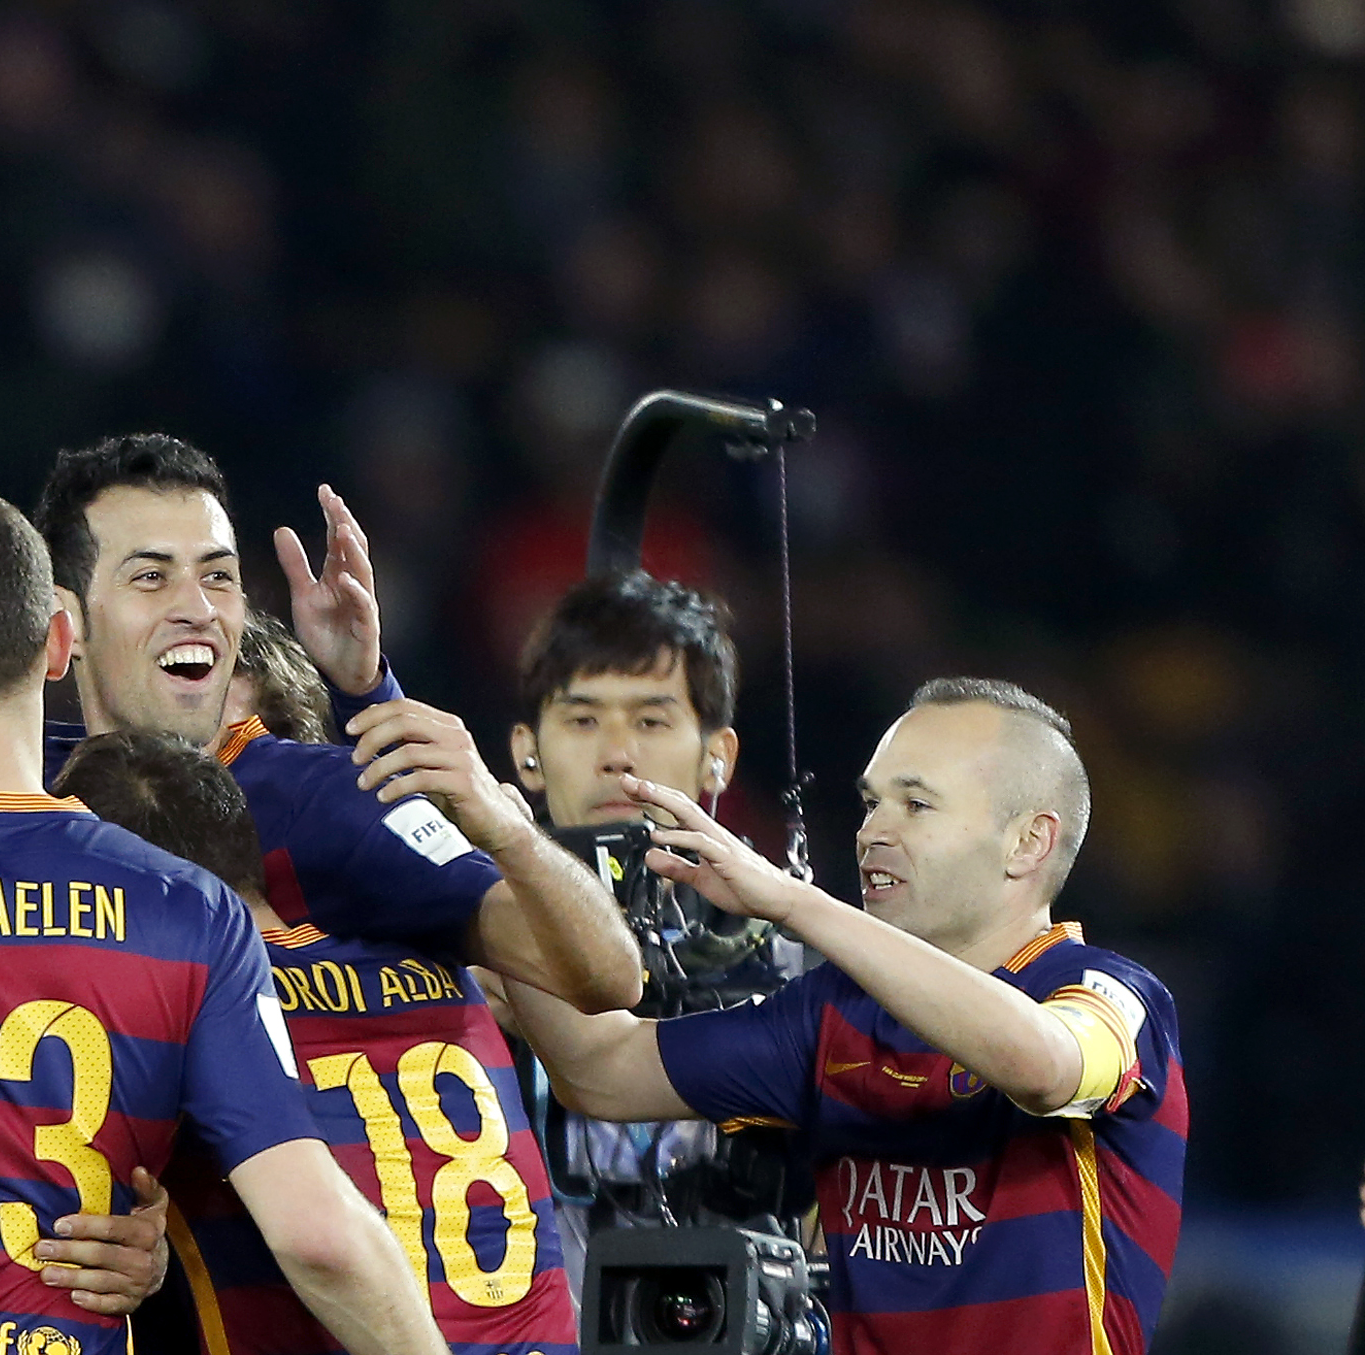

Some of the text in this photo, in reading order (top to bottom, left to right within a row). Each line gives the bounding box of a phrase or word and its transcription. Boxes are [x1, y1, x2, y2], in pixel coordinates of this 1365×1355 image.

[272, 961, 367, 1013] ORDI
[306, 1041, 537, 1308] 18
[838, 1156, 987, 1228] QATAR
